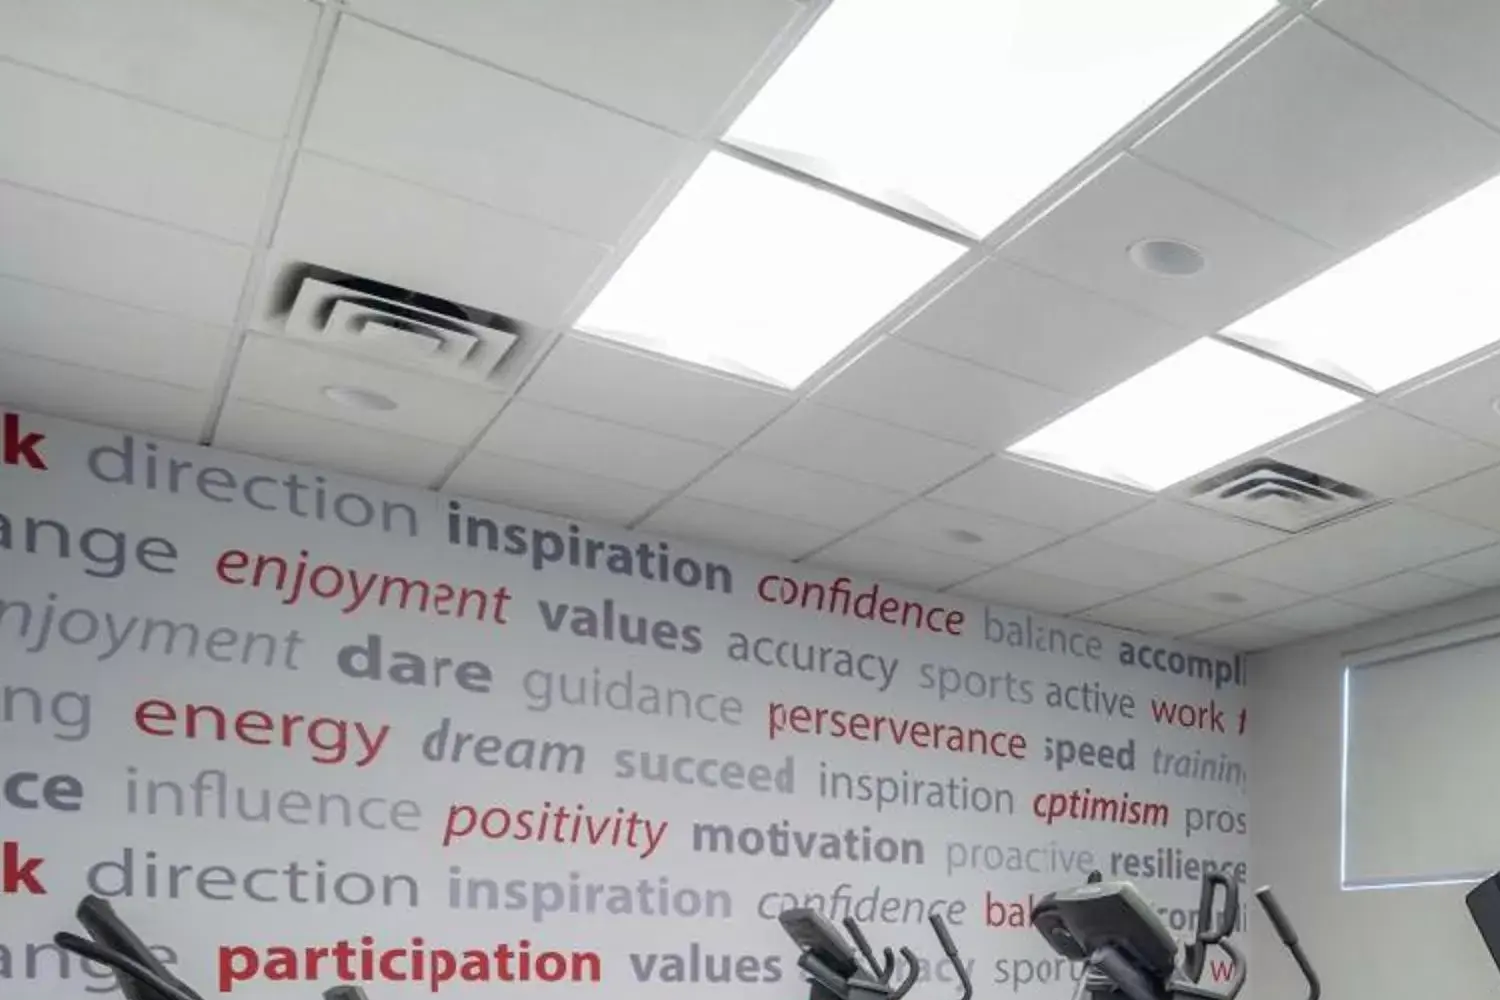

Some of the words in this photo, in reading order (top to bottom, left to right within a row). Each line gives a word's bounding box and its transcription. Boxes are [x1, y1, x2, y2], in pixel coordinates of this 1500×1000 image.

[87, 435, 418, 537] direction
[448, 501, 733, 594] inspiration
[757, 572, 966, 636] confidence
[0, 592, 303, 671] njoyment
[337, 634, 493, 694] dare
[523, 668, 744, 726] guidance
[768, 699, 1027, 760] perserverance
[1153, 747, 1247, 795] trainin
[216, 550, 512, 626] enjoyment
[537, 599, 703, 655] values
[727, 630, 898, 692] accuracy
[919, 660, 1034, 704] sports
[1046, 681, 1136, 719] active
[1151, 698, 1226, 734] work
[4, 684, 92, 742] ng
[135, 698, 390, 766] energy
[422, 717, 586, 775] dream
[614, 746, 795, 795] succeed
[820, 763, 1014, 816] inspiration
[4, 770, 84, 811] ce
[127, 767, 422, 832] influence
[443, 800, 668, 858] positivity
[693, 817, 925, 865] motivation
[87, 848, 418, 907] direction
[448, 866, 733, 922] inspiration
[219, 937, 601, 992] participation
[630, 944, 783, 984] values
[994, 957, 1081, 993] sport
